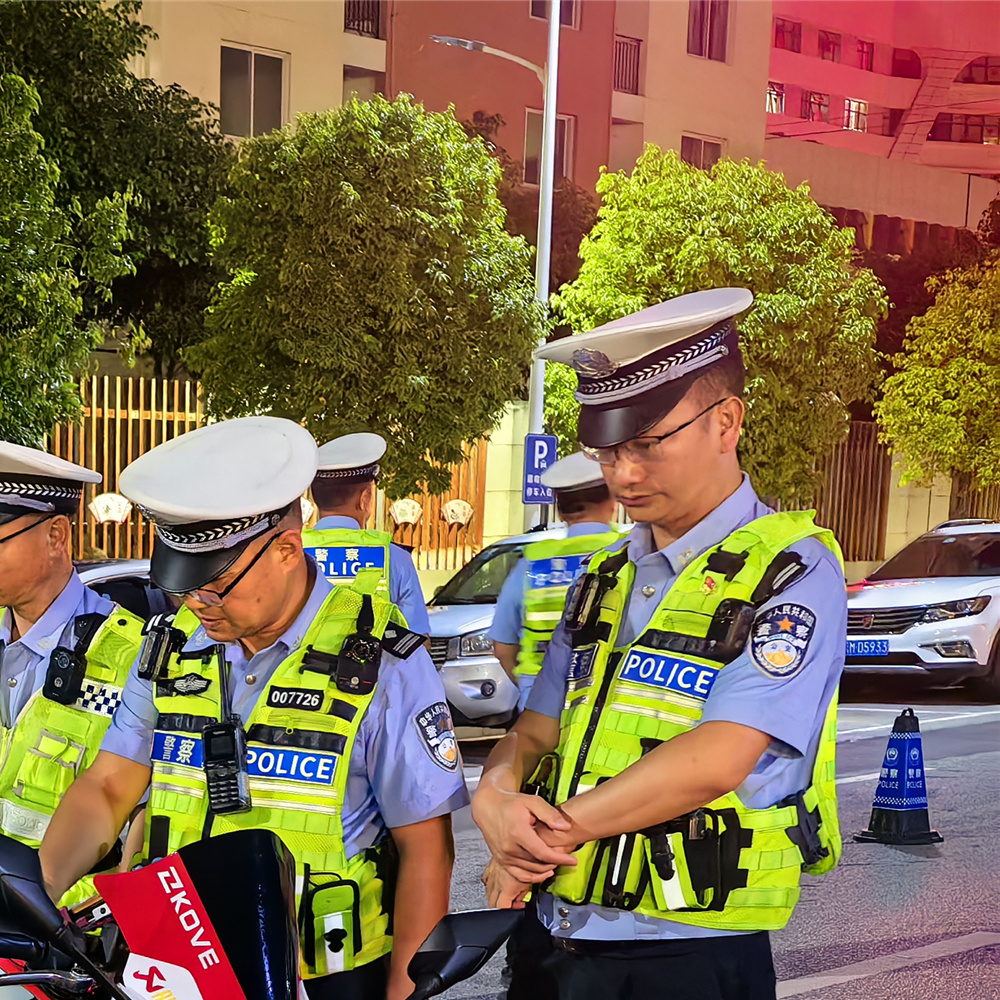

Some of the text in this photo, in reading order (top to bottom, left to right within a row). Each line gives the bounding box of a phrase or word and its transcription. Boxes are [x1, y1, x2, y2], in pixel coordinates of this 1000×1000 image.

[534, 440, 548, 469] P
[315, 548, 359, 562] 警察
[624, 654, 714, 695] POLICE
[271, 690, 320, 707] 007726
[162, 735, 196, 764] 警察
[246, 750, 333, 780] POLICE
